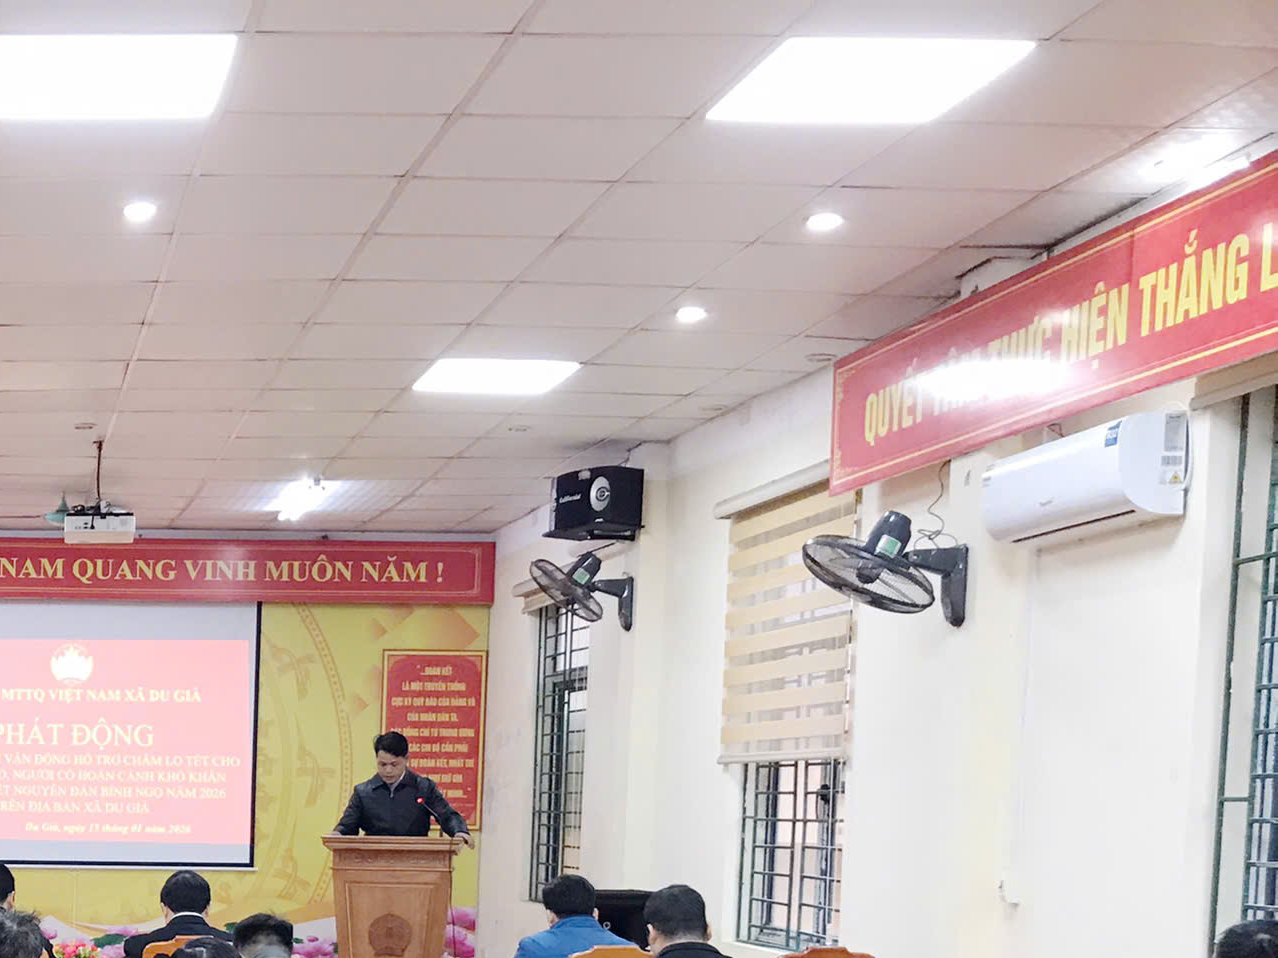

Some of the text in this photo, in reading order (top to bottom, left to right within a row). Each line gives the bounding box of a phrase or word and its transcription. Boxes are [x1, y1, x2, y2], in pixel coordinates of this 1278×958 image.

[1139, 228, 1250, 337] THẮNG
[72, 558, 177, 584] QUANG
[184, 559, 256, 581] VINH
[264, 554, 352, 582] MUÔN
[360, 555, 428, 583] NĂM
[1, 687, 46, 703] MTTQ
[87, 689, 121, 702] NAM
[149, 689, 171, 702] DU
[71, 717, 154, 751] ĐỘNG
